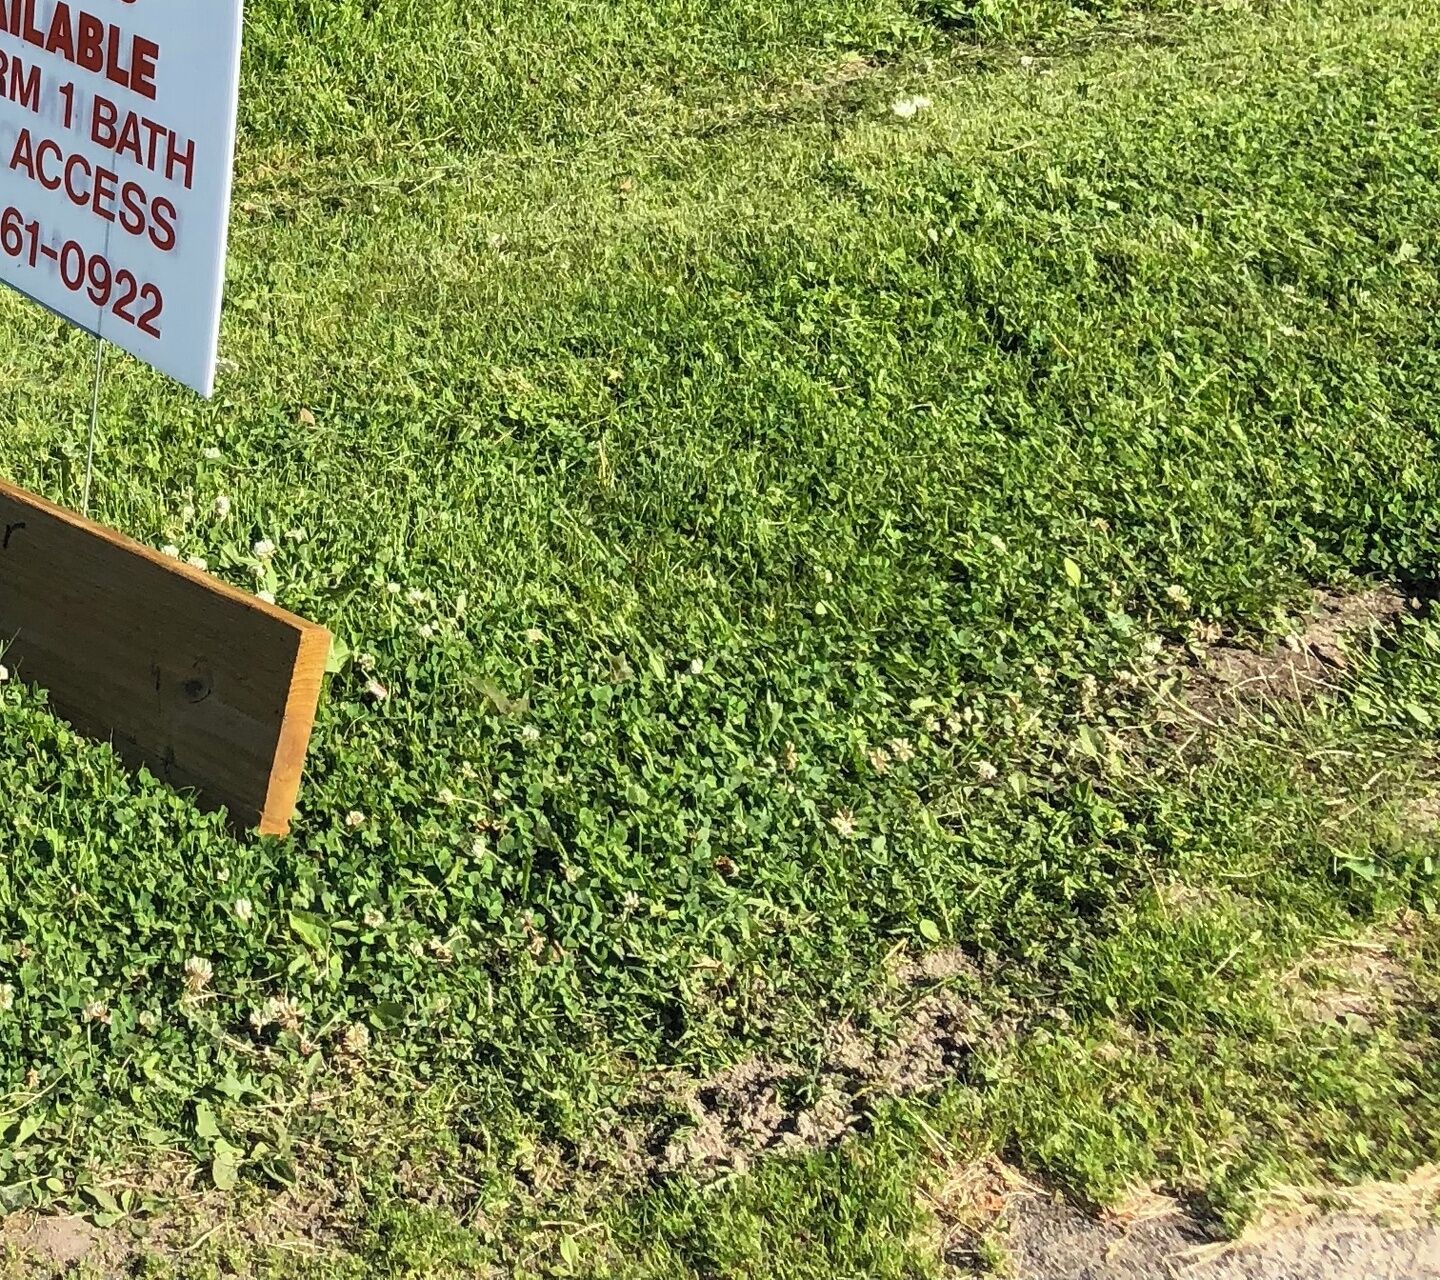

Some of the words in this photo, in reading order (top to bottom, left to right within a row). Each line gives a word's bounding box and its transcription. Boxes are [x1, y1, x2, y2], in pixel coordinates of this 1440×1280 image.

[10, 127, 178, 252] ACCESS
[58, 82, 75, 130] 1
[91, 95, 196, 191] BATH
